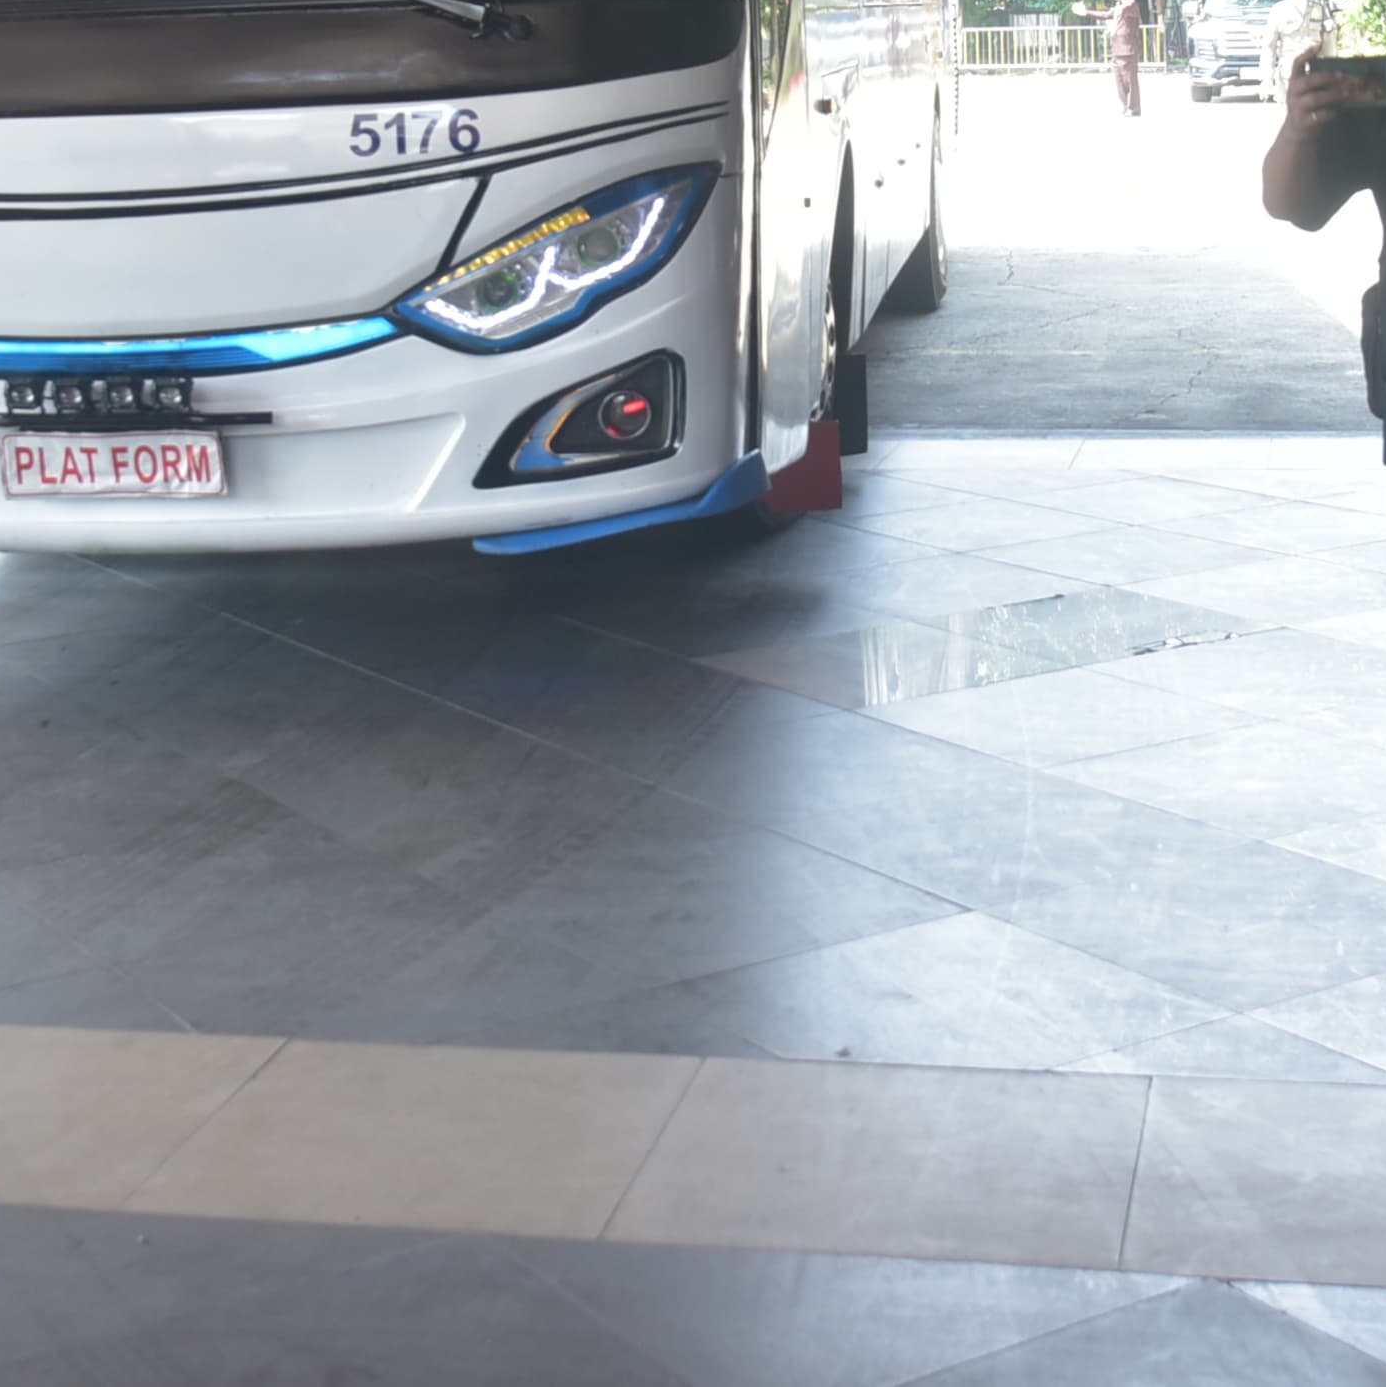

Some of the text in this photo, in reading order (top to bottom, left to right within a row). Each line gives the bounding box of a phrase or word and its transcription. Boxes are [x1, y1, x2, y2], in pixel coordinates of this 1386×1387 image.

[349, 109, 481, 156] 5176
[15, 445, 212, 484] PLAT FORM
